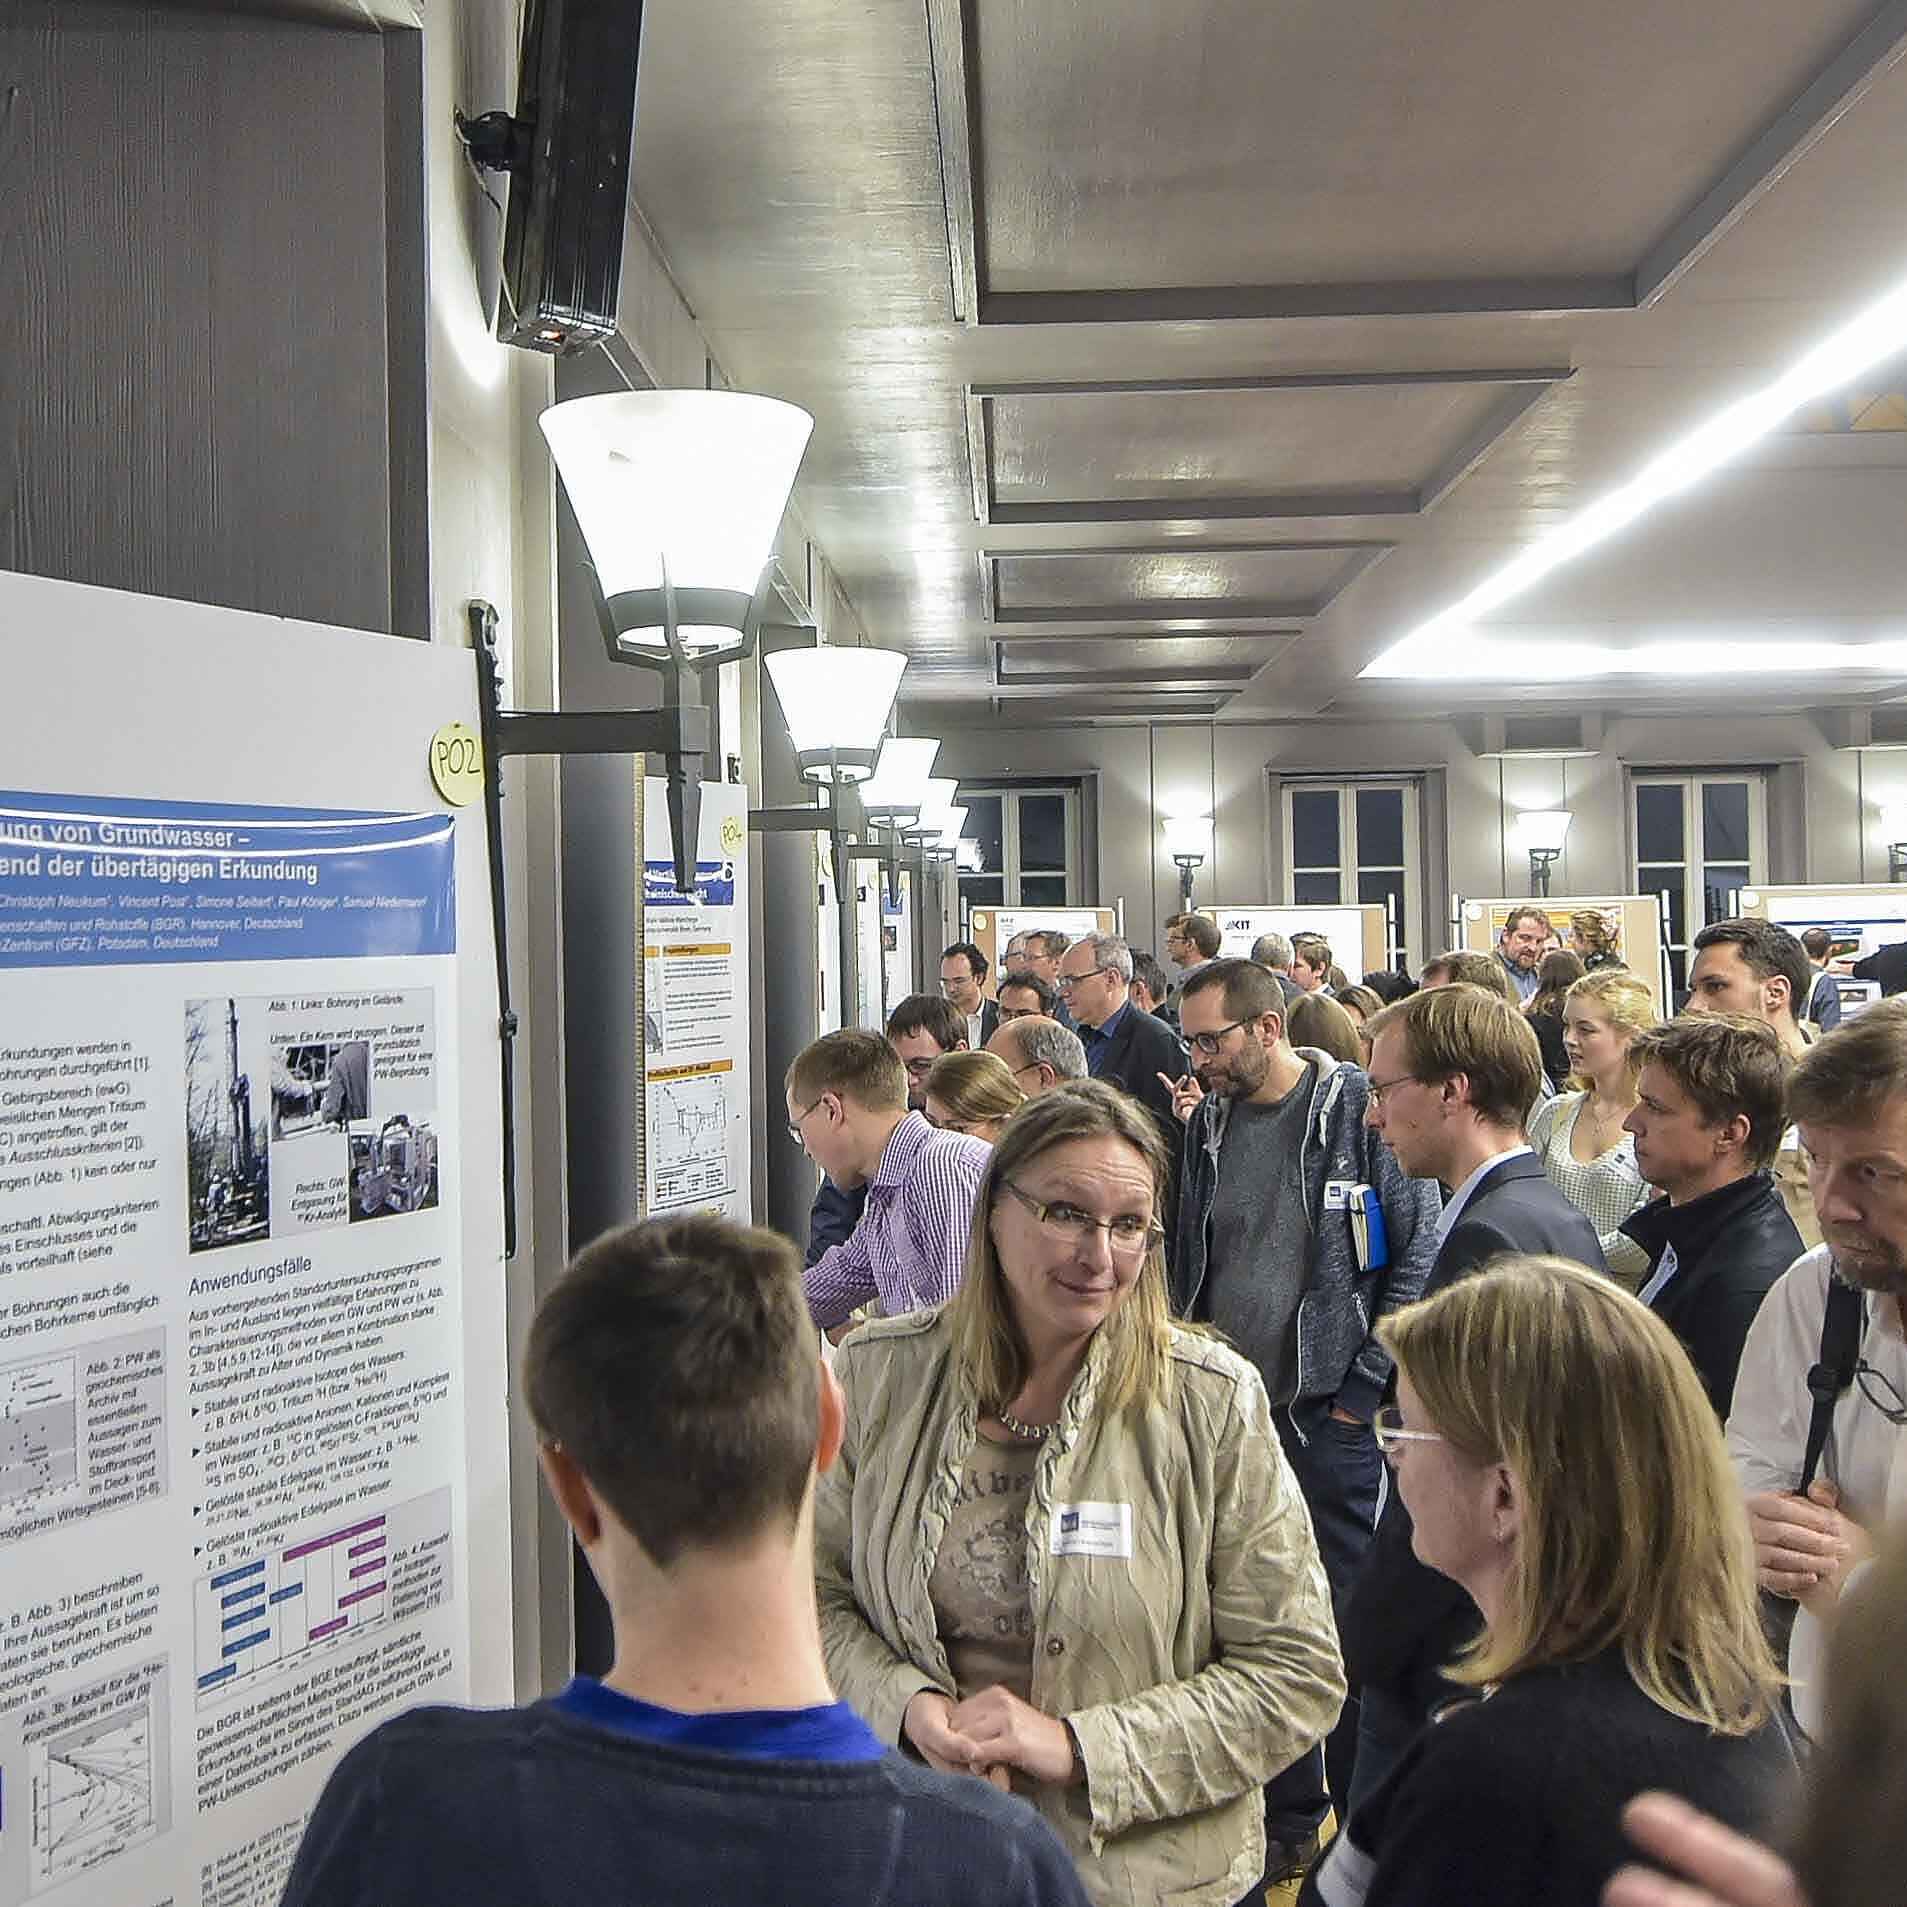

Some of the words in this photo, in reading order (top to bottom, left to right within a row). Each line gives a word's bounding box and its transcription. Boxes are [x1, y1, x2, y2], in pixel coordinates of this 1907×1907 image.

[51, 825, 92, 843] von
[98, 823, 233, 848] Grundwasser
[0, 853, 41, 877] end
[48, 854, 84, 877] der
[91, 855, 214, 884] übertägigen
[219, 858, 318, 885] Erkundung
[75, 1042, 118, 1056] werden
[121, 1040, 131, 1051] in
[59, 1059, 131, 1076] durchgeführt
[58, 1105, 105, 1120] Mengen
[110, 1161, 135, 1175] oder
[138, 1158, 157, 1171] nur
[15, 1229, 93, 1252] Einschlusses
[96, 1223, 117, 1238] und
[120, 1221, 137, 1234] die
[188, 1256, 311, 1296] Anwendungsfälle
[12, 1294, 78, 1317] Bohrungen
[82, 1287, 109, 1303] auch
[112, 1283, 130, 1296] die
